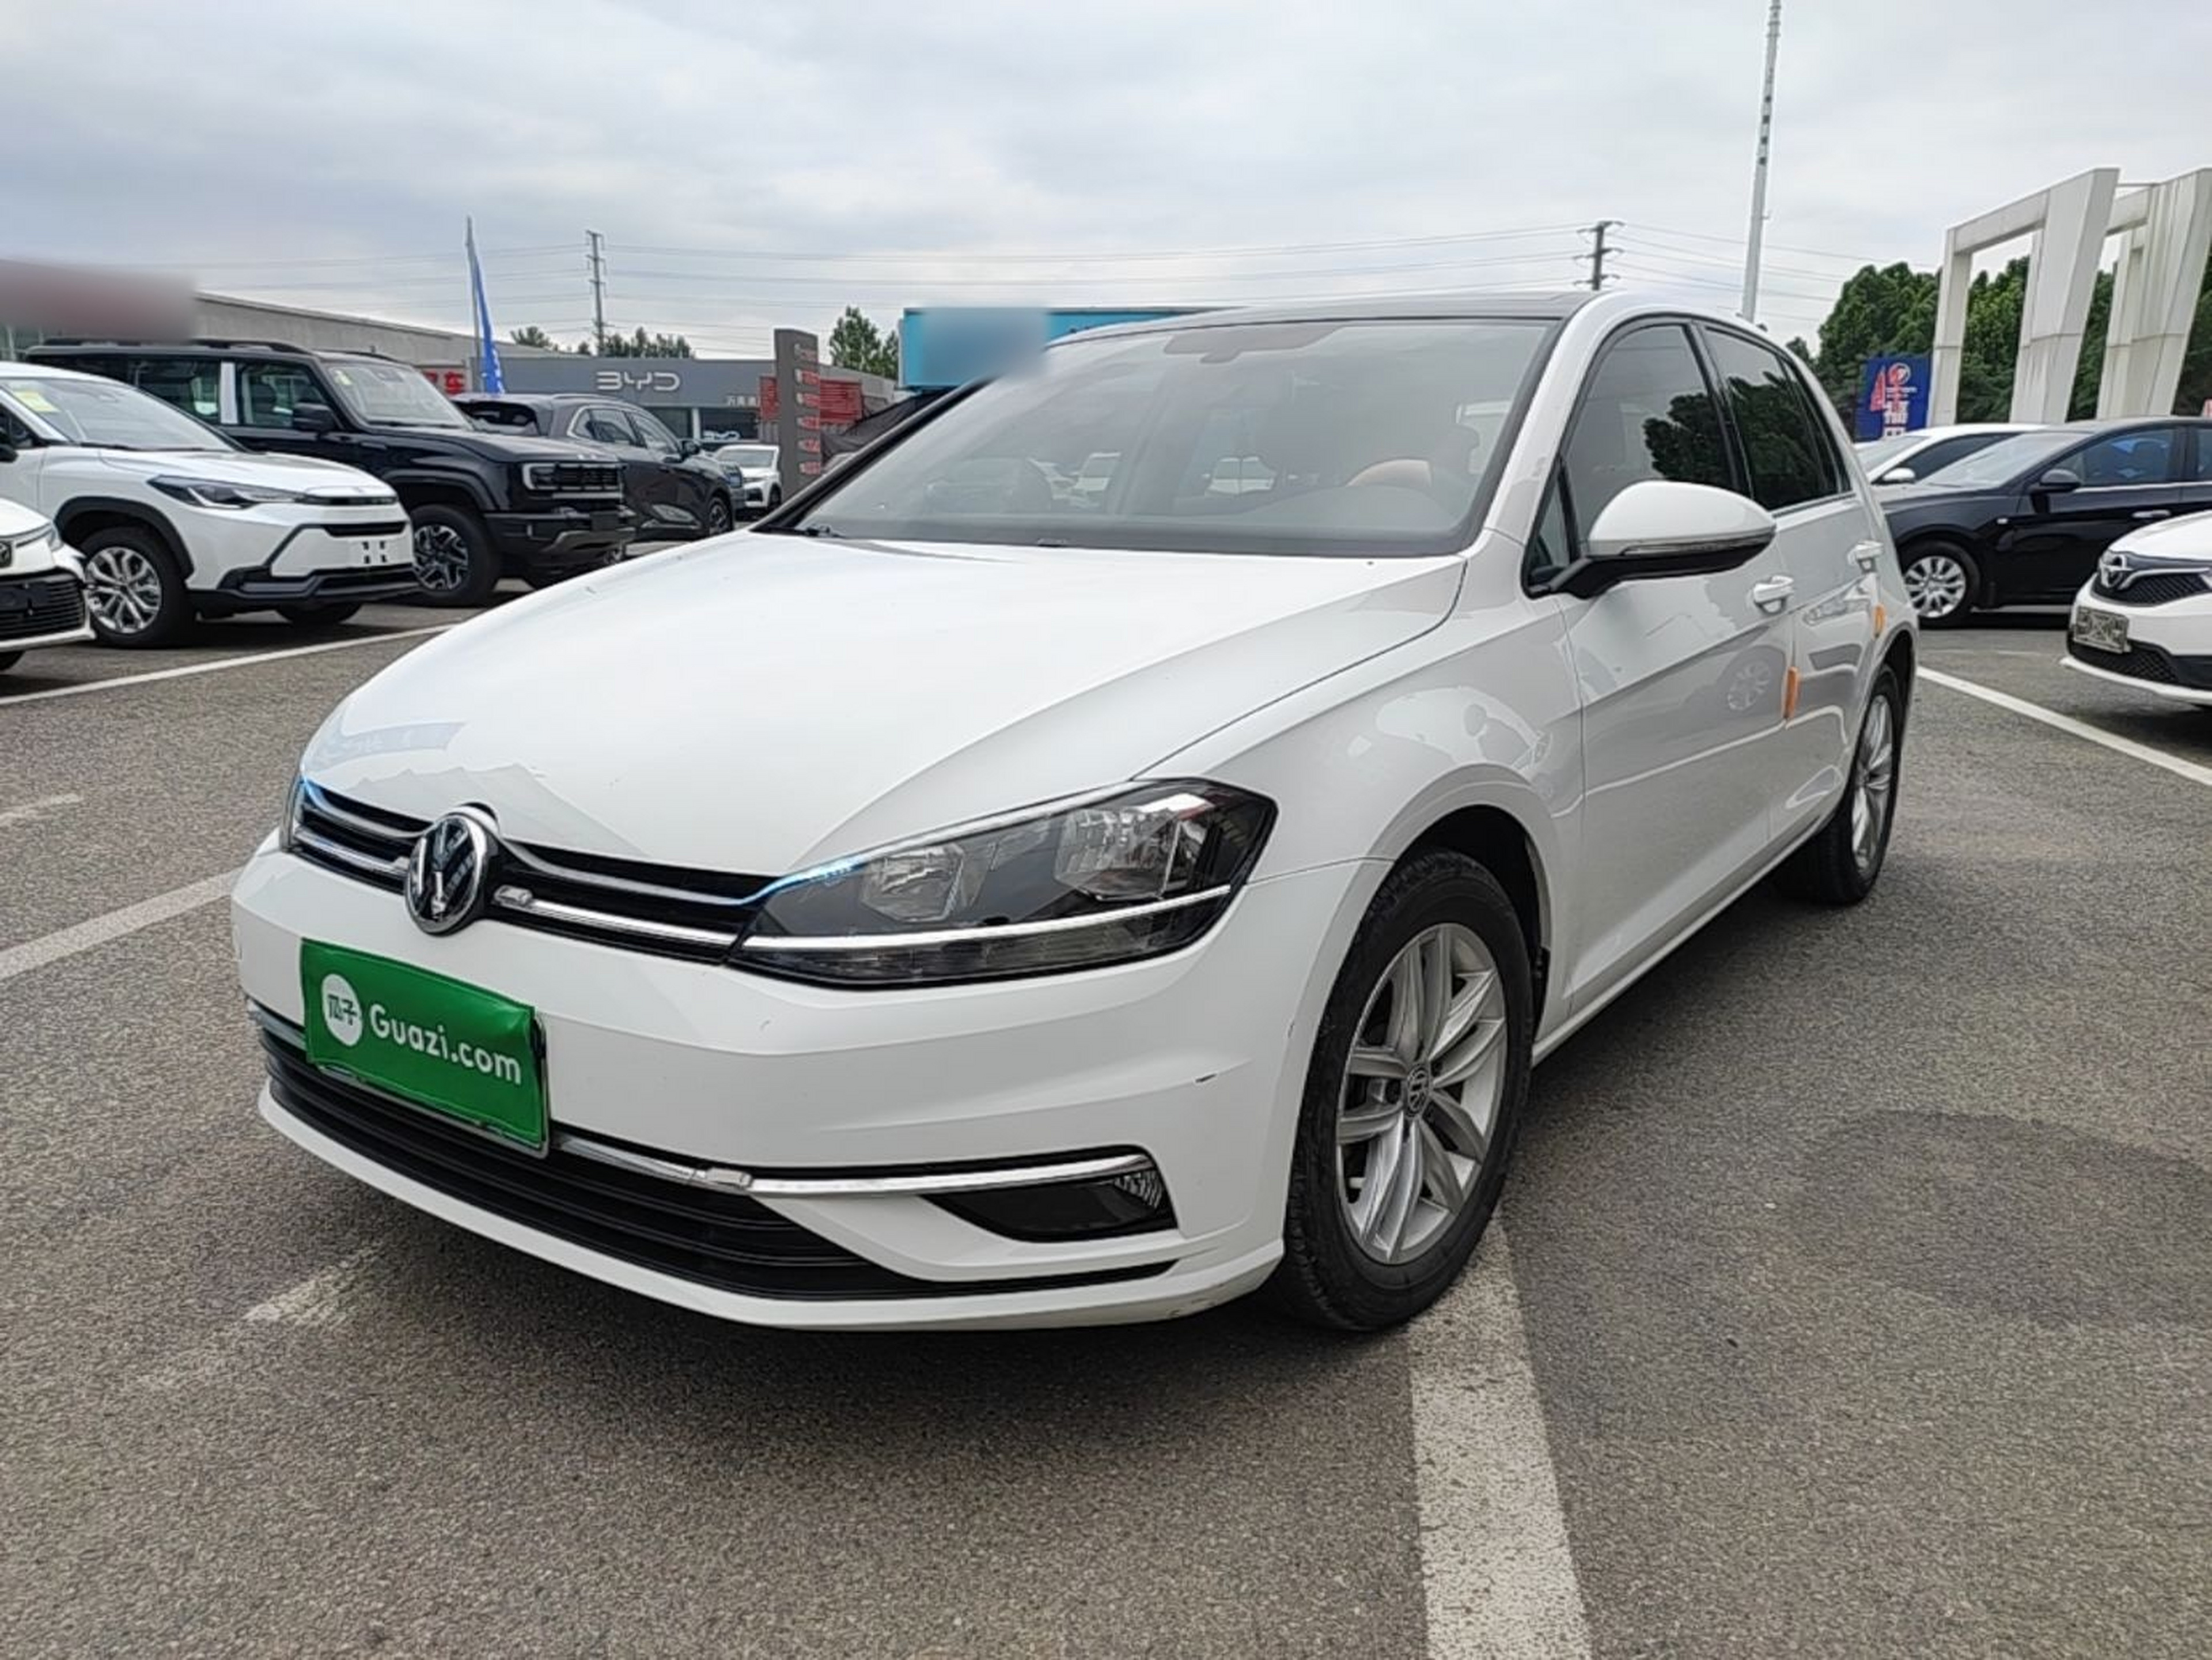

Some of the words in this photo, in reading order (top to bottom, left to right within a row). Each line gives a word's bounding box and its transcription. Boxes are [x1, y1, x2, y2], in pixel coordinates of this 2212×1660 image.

[596, 371, 681, 391] BYD
[327, 994, 358, 1026] 瓜子
[370, 1003, 521, 1085] Guazi.com
